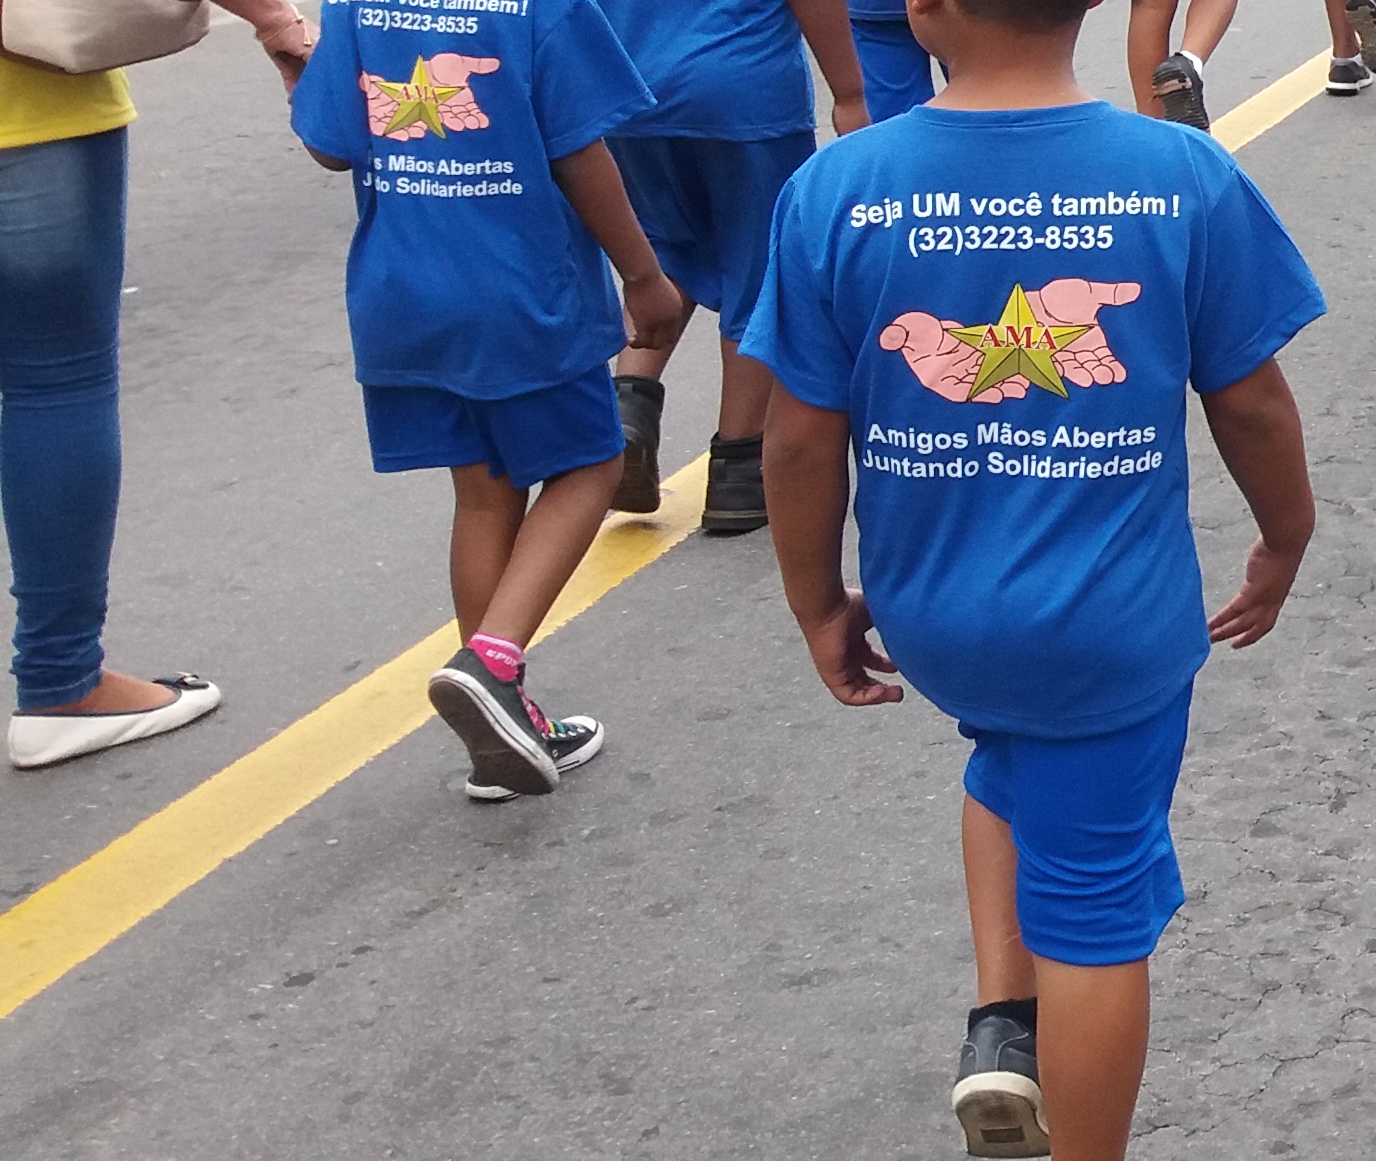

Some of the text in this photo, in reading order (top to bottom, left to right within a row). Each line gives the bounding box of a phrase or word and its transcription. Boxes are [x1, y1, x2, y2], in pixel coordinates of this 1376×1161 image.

[357, 6, 478, 35] (32)3223-8535
[388, 153, 515, 176] Mãos Abertas
[396, 177, 523, 198] Solidariedade
[849, 190, 1167, 229] Seja UM você também
[907, 224, 1114, 259] (32)3223-8535
[978, 323, 1058, 352] AMA
[867, 421, 1157, 455] Amigos Mãos Abertas
[861, 450, 1163, 480] Juntando Solidariedade
